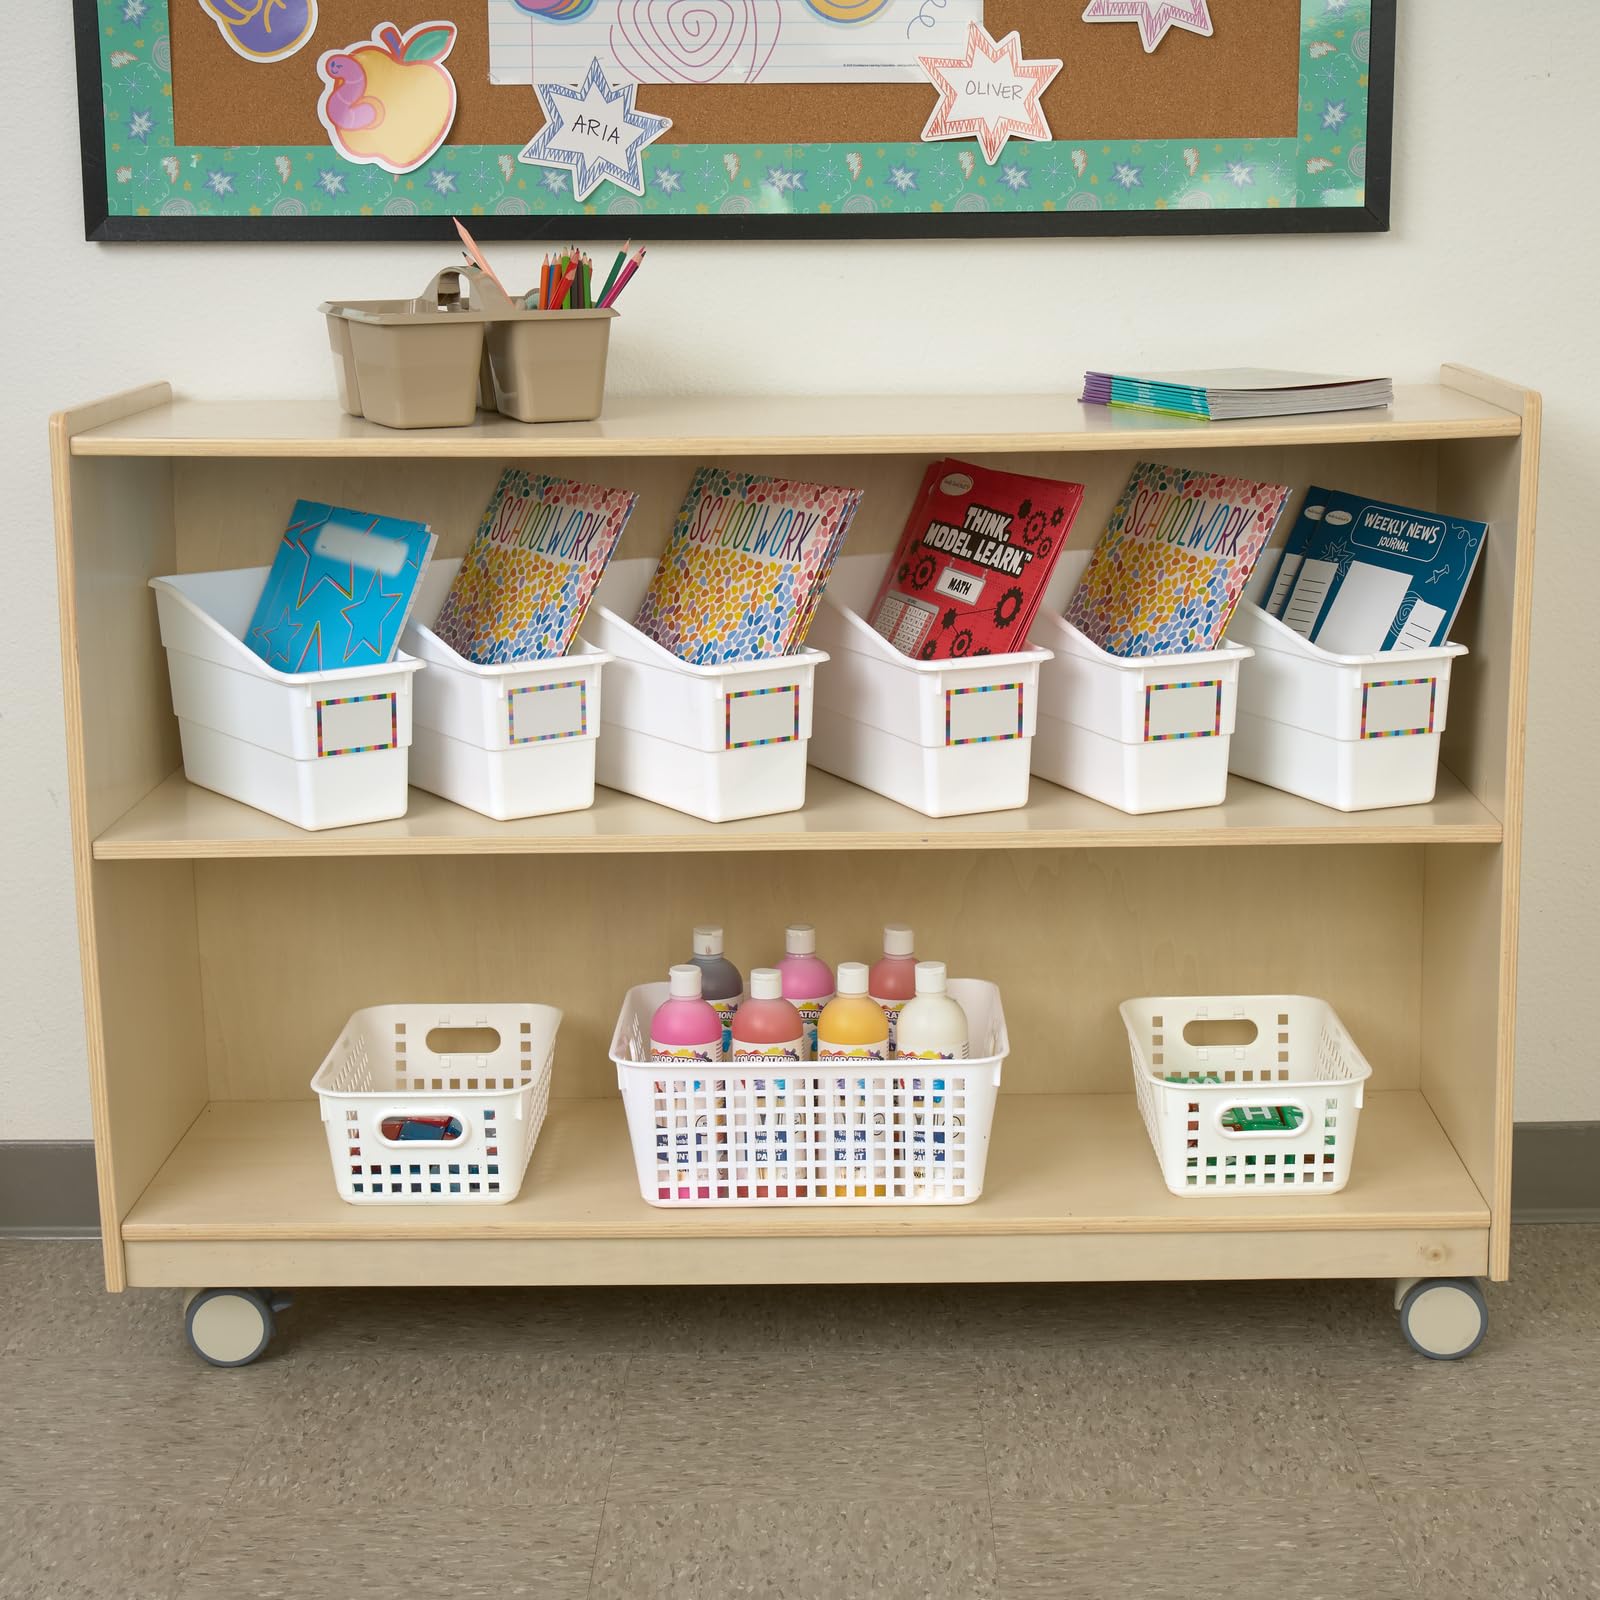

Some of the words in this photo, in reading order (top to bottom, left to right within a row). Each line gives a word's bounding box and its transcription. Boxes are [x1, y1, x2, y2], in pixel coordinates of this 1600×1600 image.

[965, 80, 1024, 101] OLIVER
[571, 114, 620, 145] ARIA
[491, 495, 607, 563] SCHOOLWORK
[689, 494, 820, 562] SCHOOLWORK
[963, 506, 1013, 542] THINK.
[1124, 489, 1257, 557] SCHOOLWORK
[1364, 512, 1409, 537] WEEKLY
[1405, 521, 1441, 545] NEWS
[923, 522, 973, 559] MODEL.
[1376, 535, 1410, 553] JOURNAL
[947, 577, 973, 596] MATH
